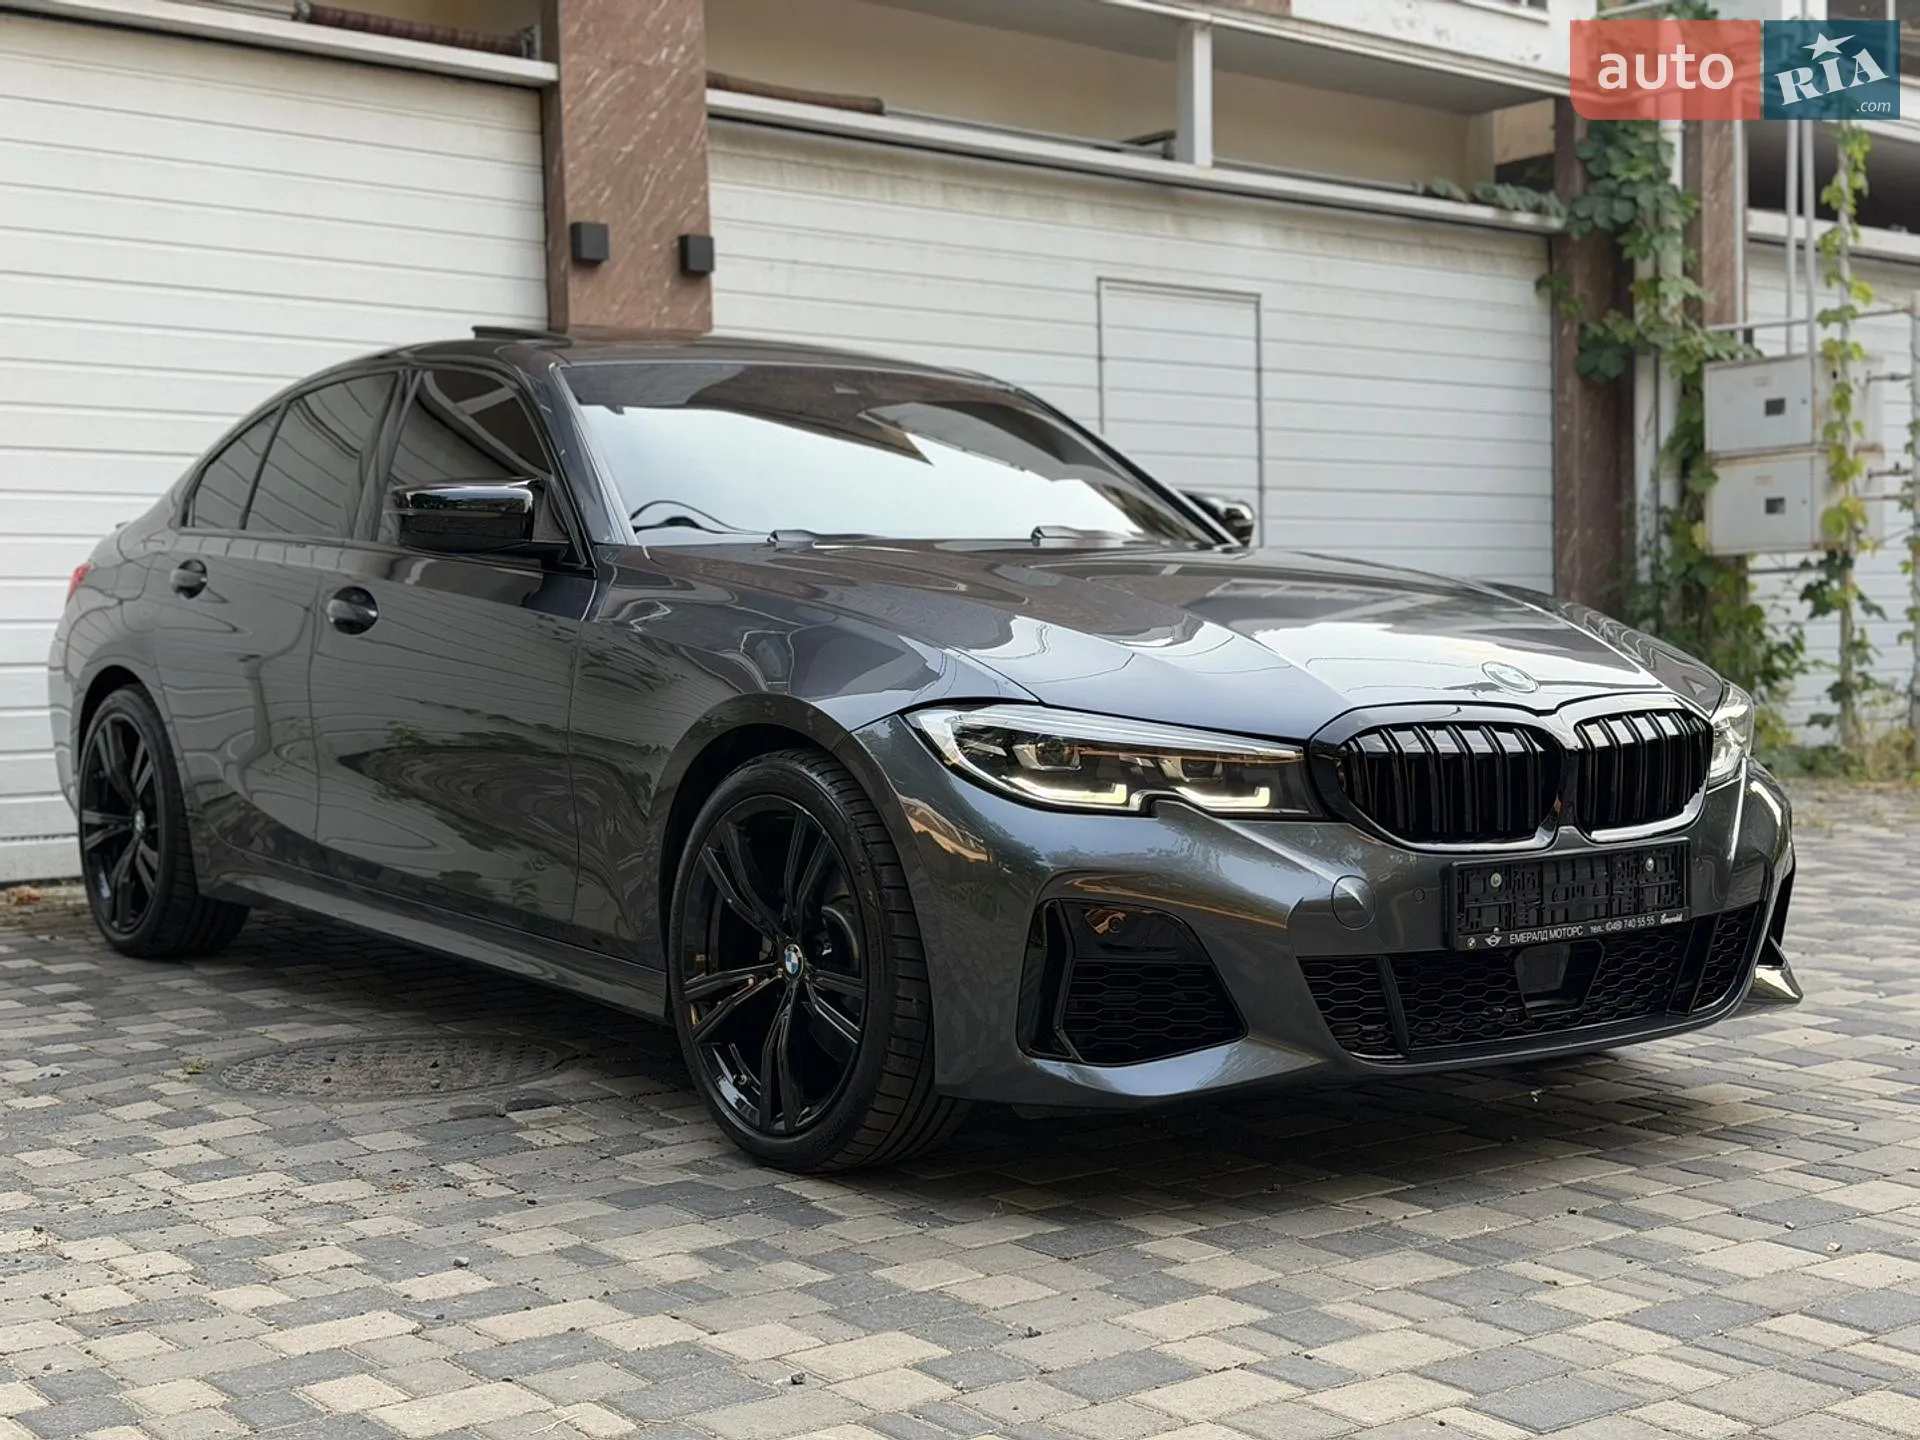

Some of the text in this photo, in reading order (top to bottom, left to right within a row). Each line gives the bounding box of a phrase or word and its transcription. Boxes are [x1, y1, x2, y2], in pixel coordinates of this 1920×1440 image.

[1509, 930, 1548, 944] ЕМЕРАЛД
[1549, 925, 1584, 939] МОТОРС
[1637, 916, 1645, 927] 55
[1646, 915, 1655, 926] 55
